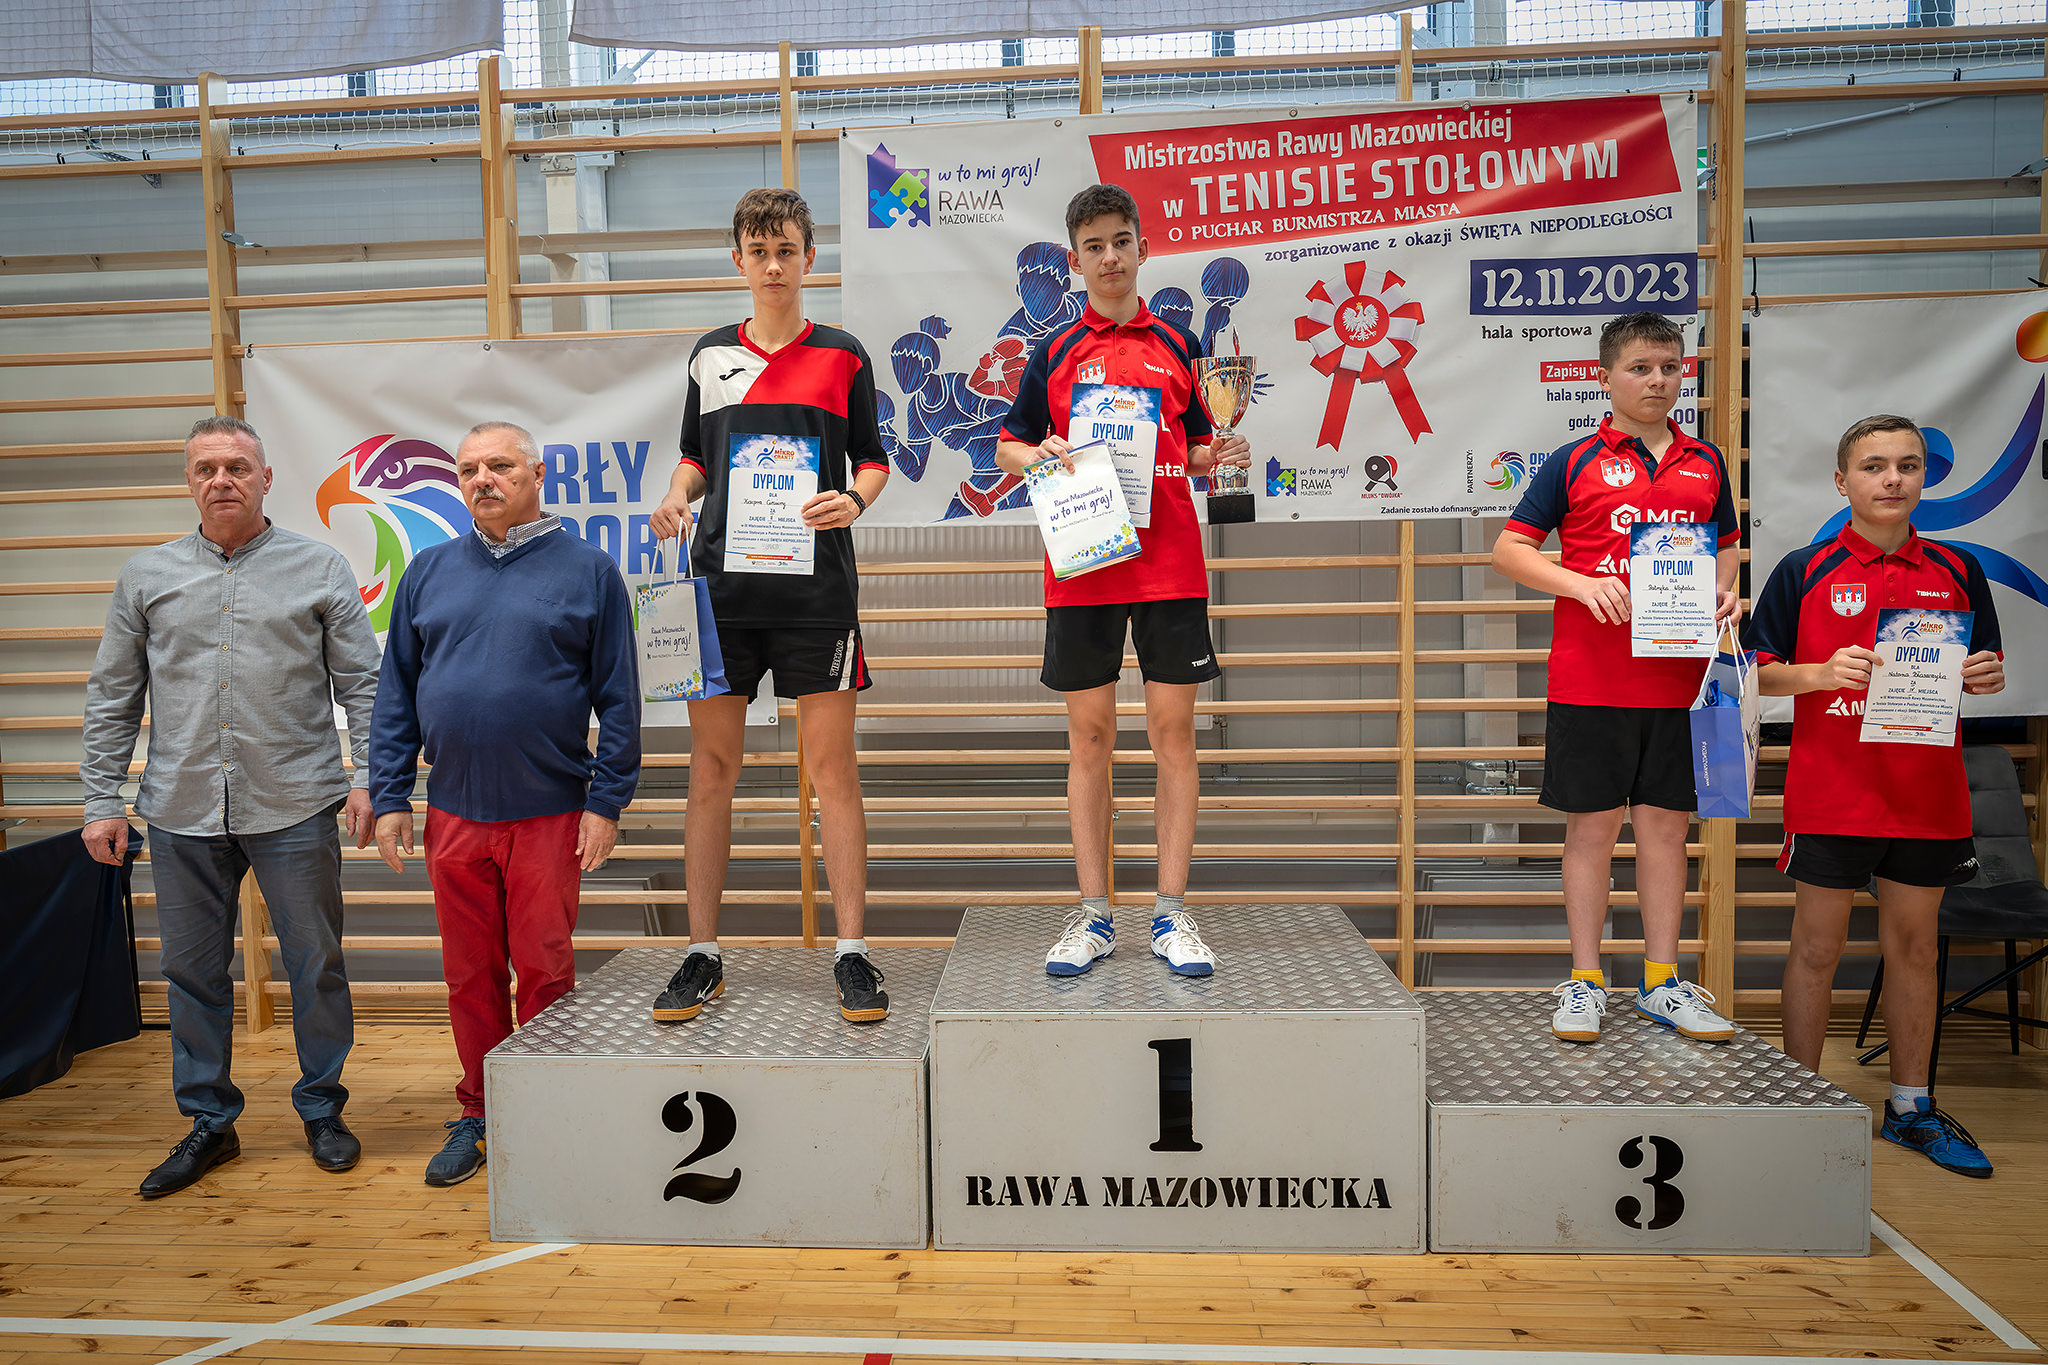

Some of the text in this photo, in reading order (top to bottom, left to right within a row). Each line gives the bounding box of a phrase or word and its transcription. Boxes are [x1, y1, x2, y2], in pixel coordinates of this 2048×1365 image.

[1124, 108, 1513, 172] Mistrzostwa Rawy Mazowieckiej
[938, 157, 1041, 189] w to mi graj!
[1162, 138, 1619, 218] w TENISIE STOŁOWYM
[938, 189, 1004, 212] RAWA
[938, 212, 1005, 226] MAZOWIECKA
[1168, 202, 1461, 242] O PUCHAR BURMISTRZA MIASTA
[1264, 205, 1673, 262] zorganizowane z okazji ŚWIĘTA NIEPODLEGŁOŚCI
[1481, 261, 1690, 308] 12.11.2023
[1481, 325, 1513, 340] hala
[1521, 325, 1592, 342] sportowa
[1546, 363, 1587, 380] Zapisy
[1546, 388, 1573, 402] hala
[1092, 422, 1134, 441] DYPLOM
[1568, 414, 1600, 431] godz.
[542, 440, 651, 505] RŁY
[1155, 462, 1186, 478] stal
[1309, 466, 1317, 476] to
[1318, 467, 1328, 475] mi
[1330, 464, 1350, 480] graj!
[1466, 449, 1474, 495] PARTNERZY:
[753, 473, 794, 491] DYPLOM
[1300, 479, 1332, 490] RAWA
[1070, 485, 1104, 502] Mazowiecka
[1050, 512, 1059, 522] w
[1061, 506, 1071, 519] to
[1073, 501, 1087, 514] mi
[1089, 489, 1113, 514] graj!
[1380, 505, 1411, 514] Zadanie
[1411, 505, 1439, 514] zostało
[1653, 560, 1693, 576] DYPLOM
[654, 636, 661, 648] to
[662, 637, 672, 647] mi
[673, 631, 691, 652] graj!
[829, 639, 845, 677] TIBHAR
[1895, 646, 1940, 664] DYPLOM
[1148, 1037, 1204, 1153] 1
[660, 1090, 742, 1205] 2
[965, 1175, 1393, 1210] RAWA MAZOWIECKA
[1614, 1135, 1686, 1231] 3
